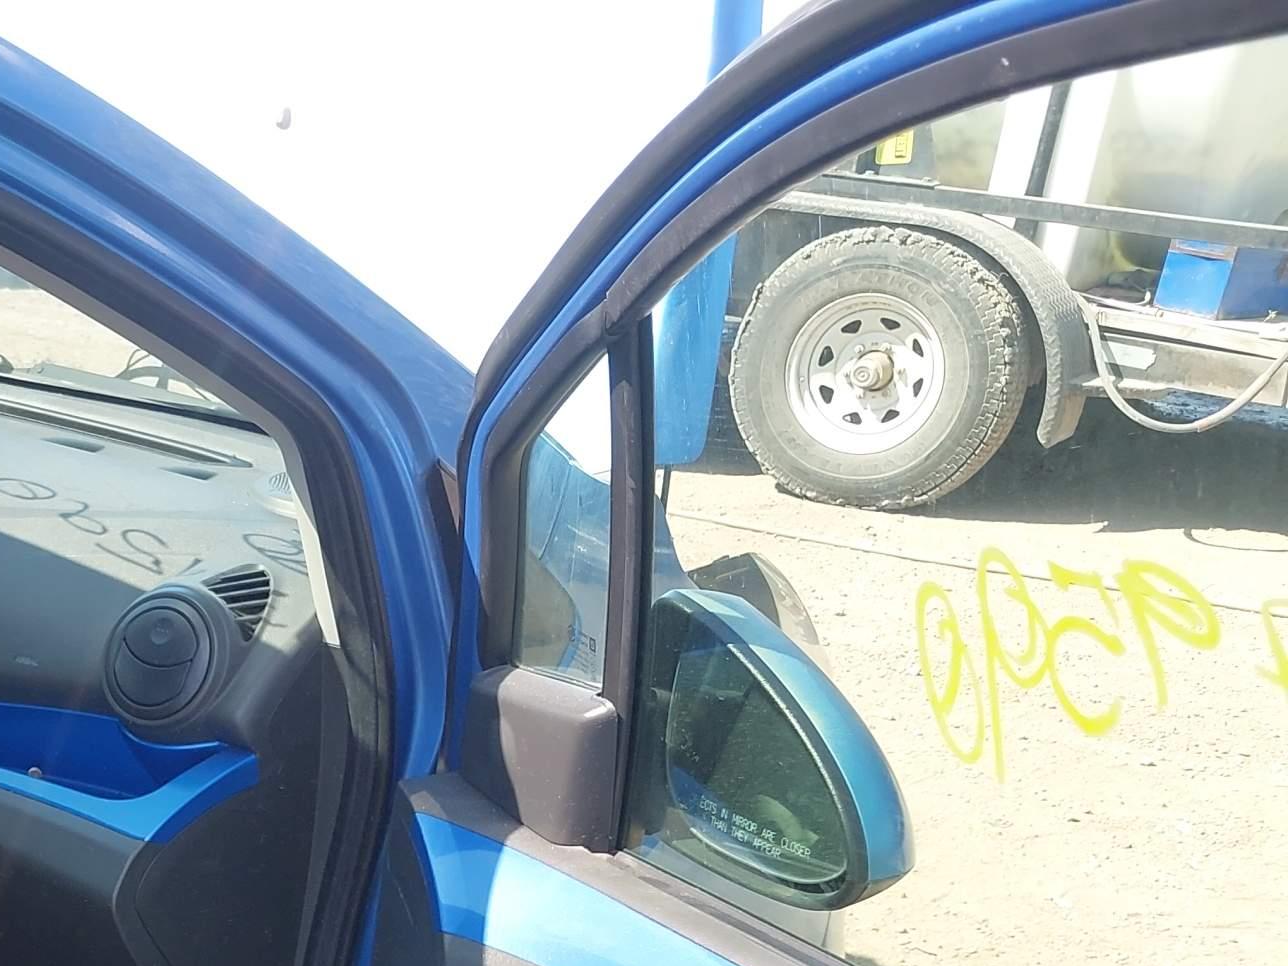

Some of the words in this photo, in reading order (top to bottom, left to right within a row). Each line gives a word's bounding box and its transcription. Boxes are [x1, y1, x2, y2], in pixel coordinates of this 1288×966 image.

[710, 816, 728, 832] THAN
[731, 825, 748, 842] THEY
[752, 837, 782, 859] APPEAR
[720, 807, 729, 819] IN
[732, 812, 759, 834] MIRROR
[761, 828, 777, 843] ARE
[780, 837, 811, 859] CLOSER
